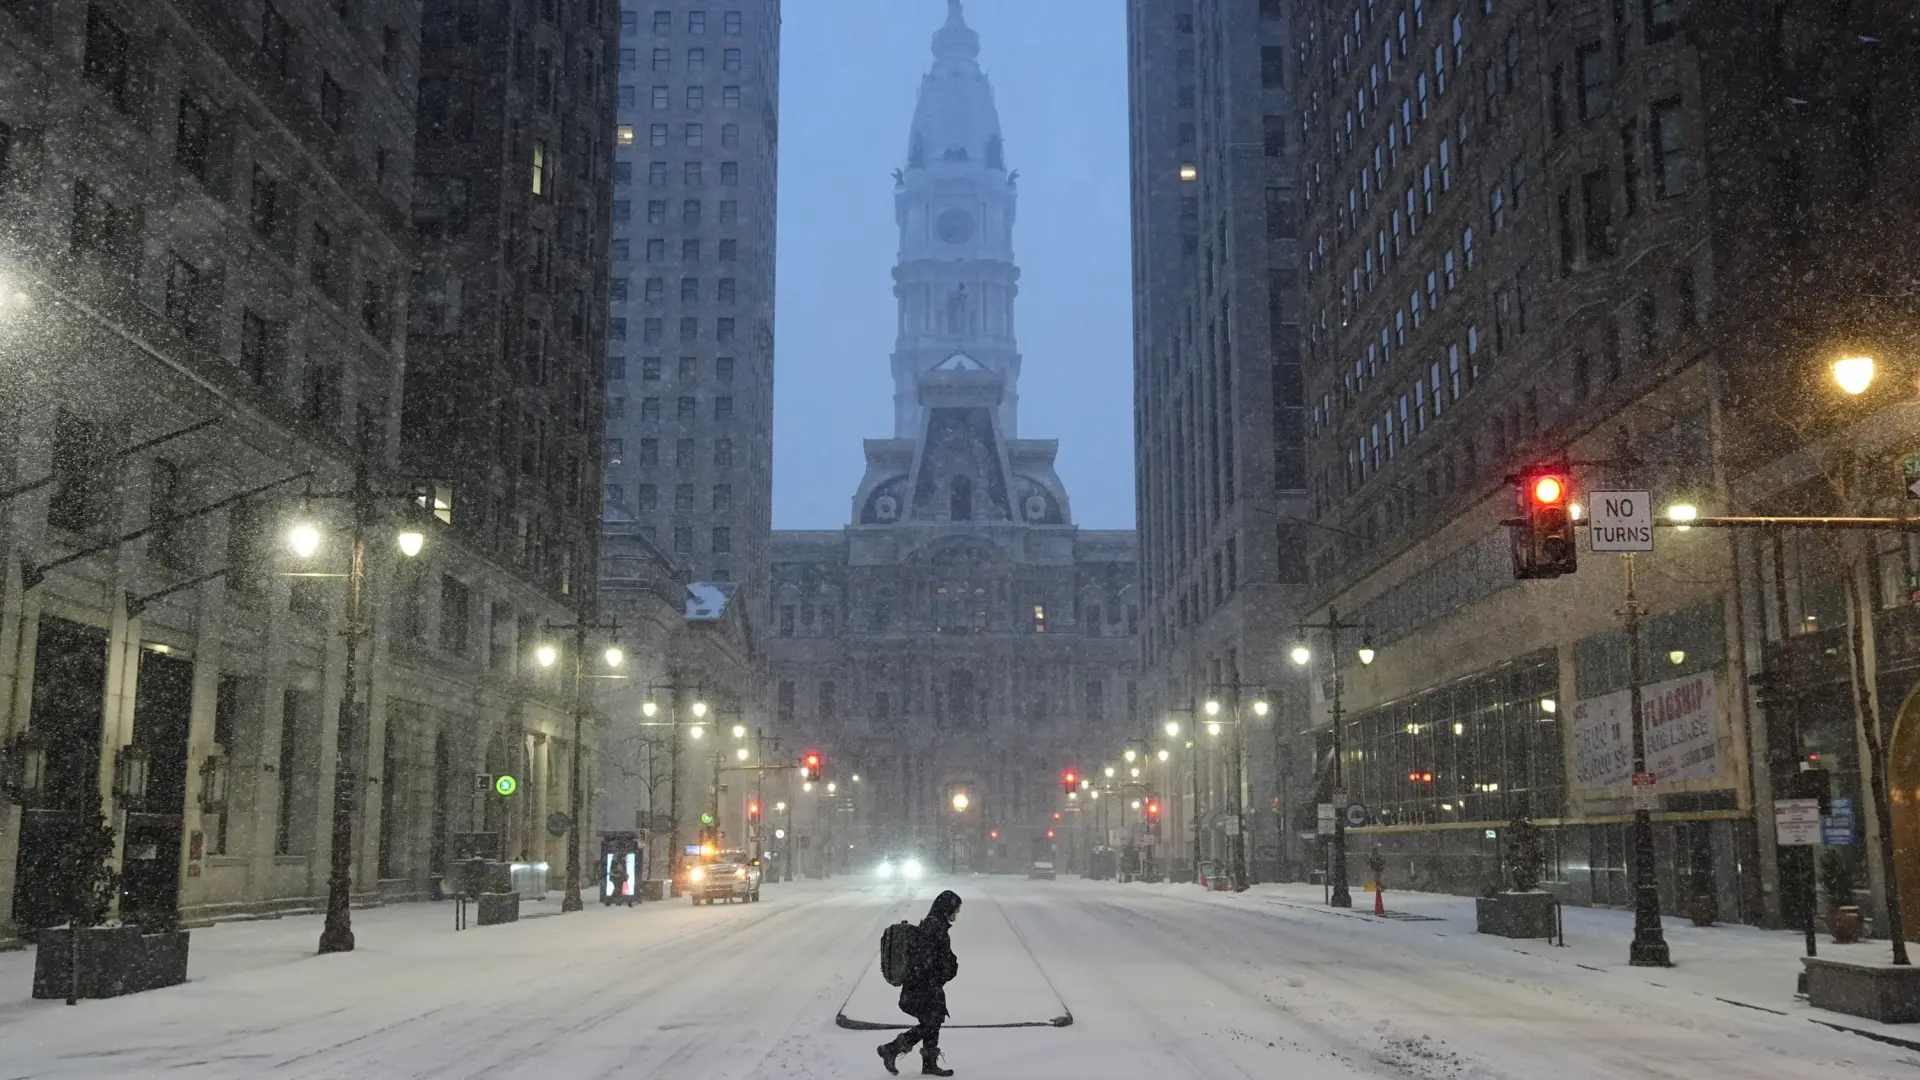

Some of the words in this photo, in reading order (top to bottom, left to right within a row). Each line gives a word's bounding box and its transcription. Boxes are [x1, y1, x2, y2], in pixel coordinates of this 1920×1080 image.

[1606, 498, 1633, 517] NO
[1593, 526, 1650, 542] TURNS
[1643, 678, 1704, 731] FLAGSHIP
